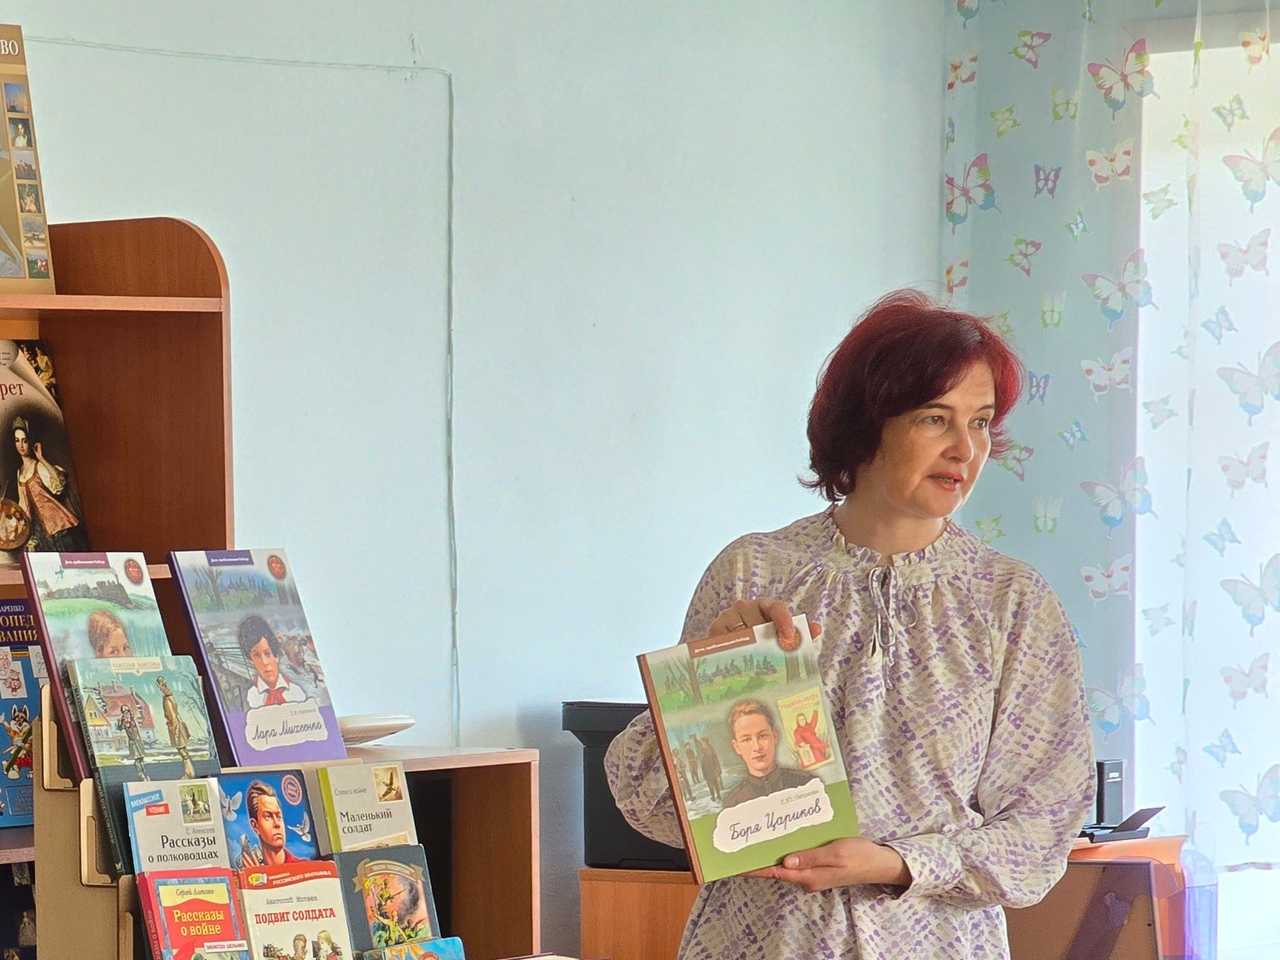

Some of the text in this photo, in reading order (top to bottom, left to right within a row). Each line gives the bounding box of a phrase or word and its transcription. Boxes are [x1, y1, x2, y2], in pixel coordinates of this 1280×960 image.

[252, 719, 322, 744] Лара Михеенко
[339, 808, 393, 823] Маленький
[729, 797, 822, 843] Боря Цариков
[342, 823, 373, 835] солдат
[160, 834, 217, 849] Рассказы
[147, 851, 219, 863] о полководцах
[172, 909, 225, 923] Рассказы
[254, 907, 336, 926] ПОДВИГ СОЛДАТА
[180, 922, 222, 936] о войне
